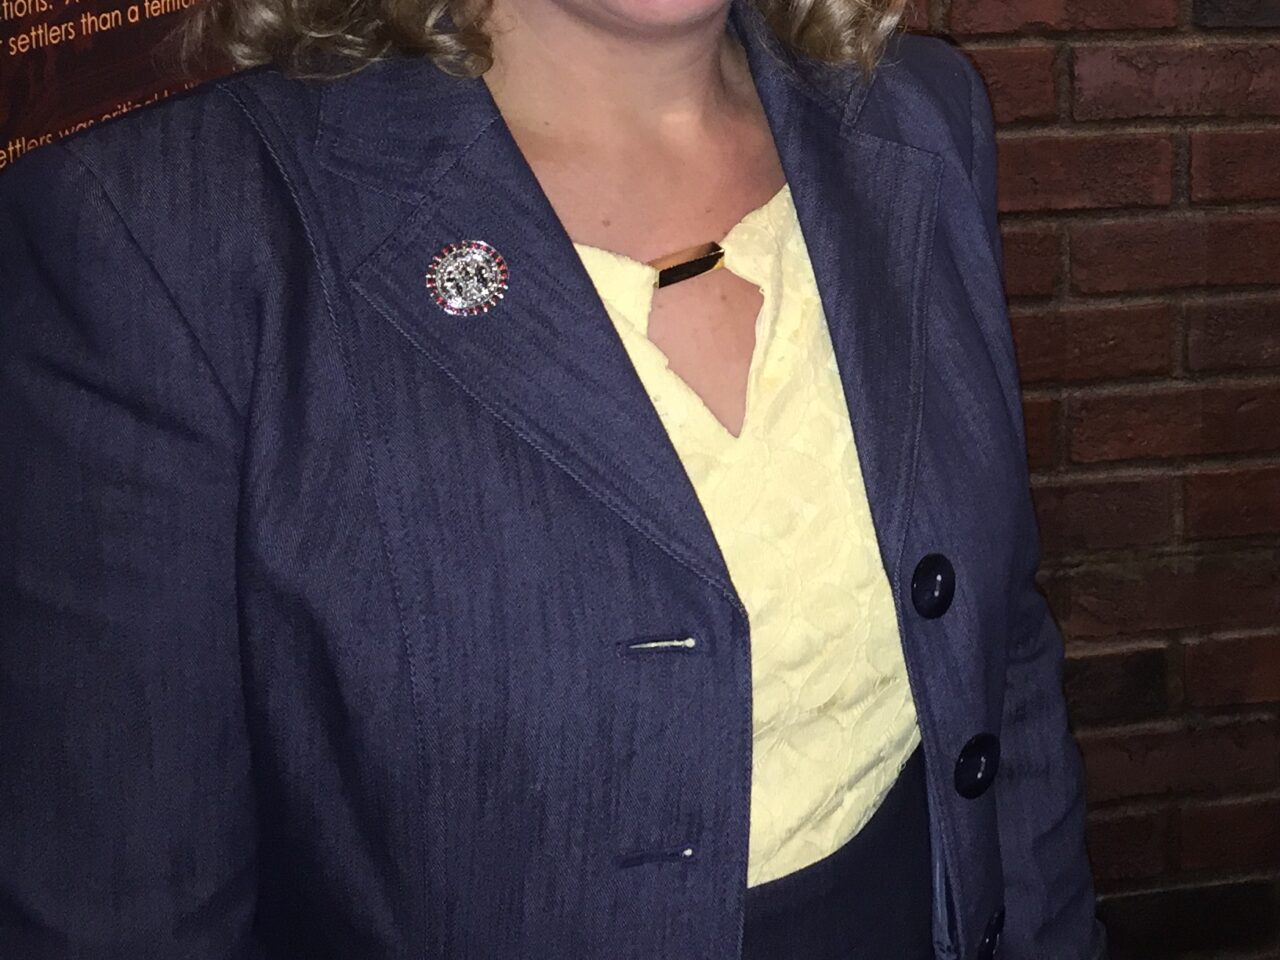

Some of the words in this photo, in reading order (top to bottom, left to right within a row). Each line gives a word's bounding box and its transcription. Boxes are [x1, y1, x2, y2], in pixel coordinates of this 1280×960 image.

[9, 20, 76, 55] settlers
[80, 8, 122, 35] than
[127, 5, 139, 23] a
